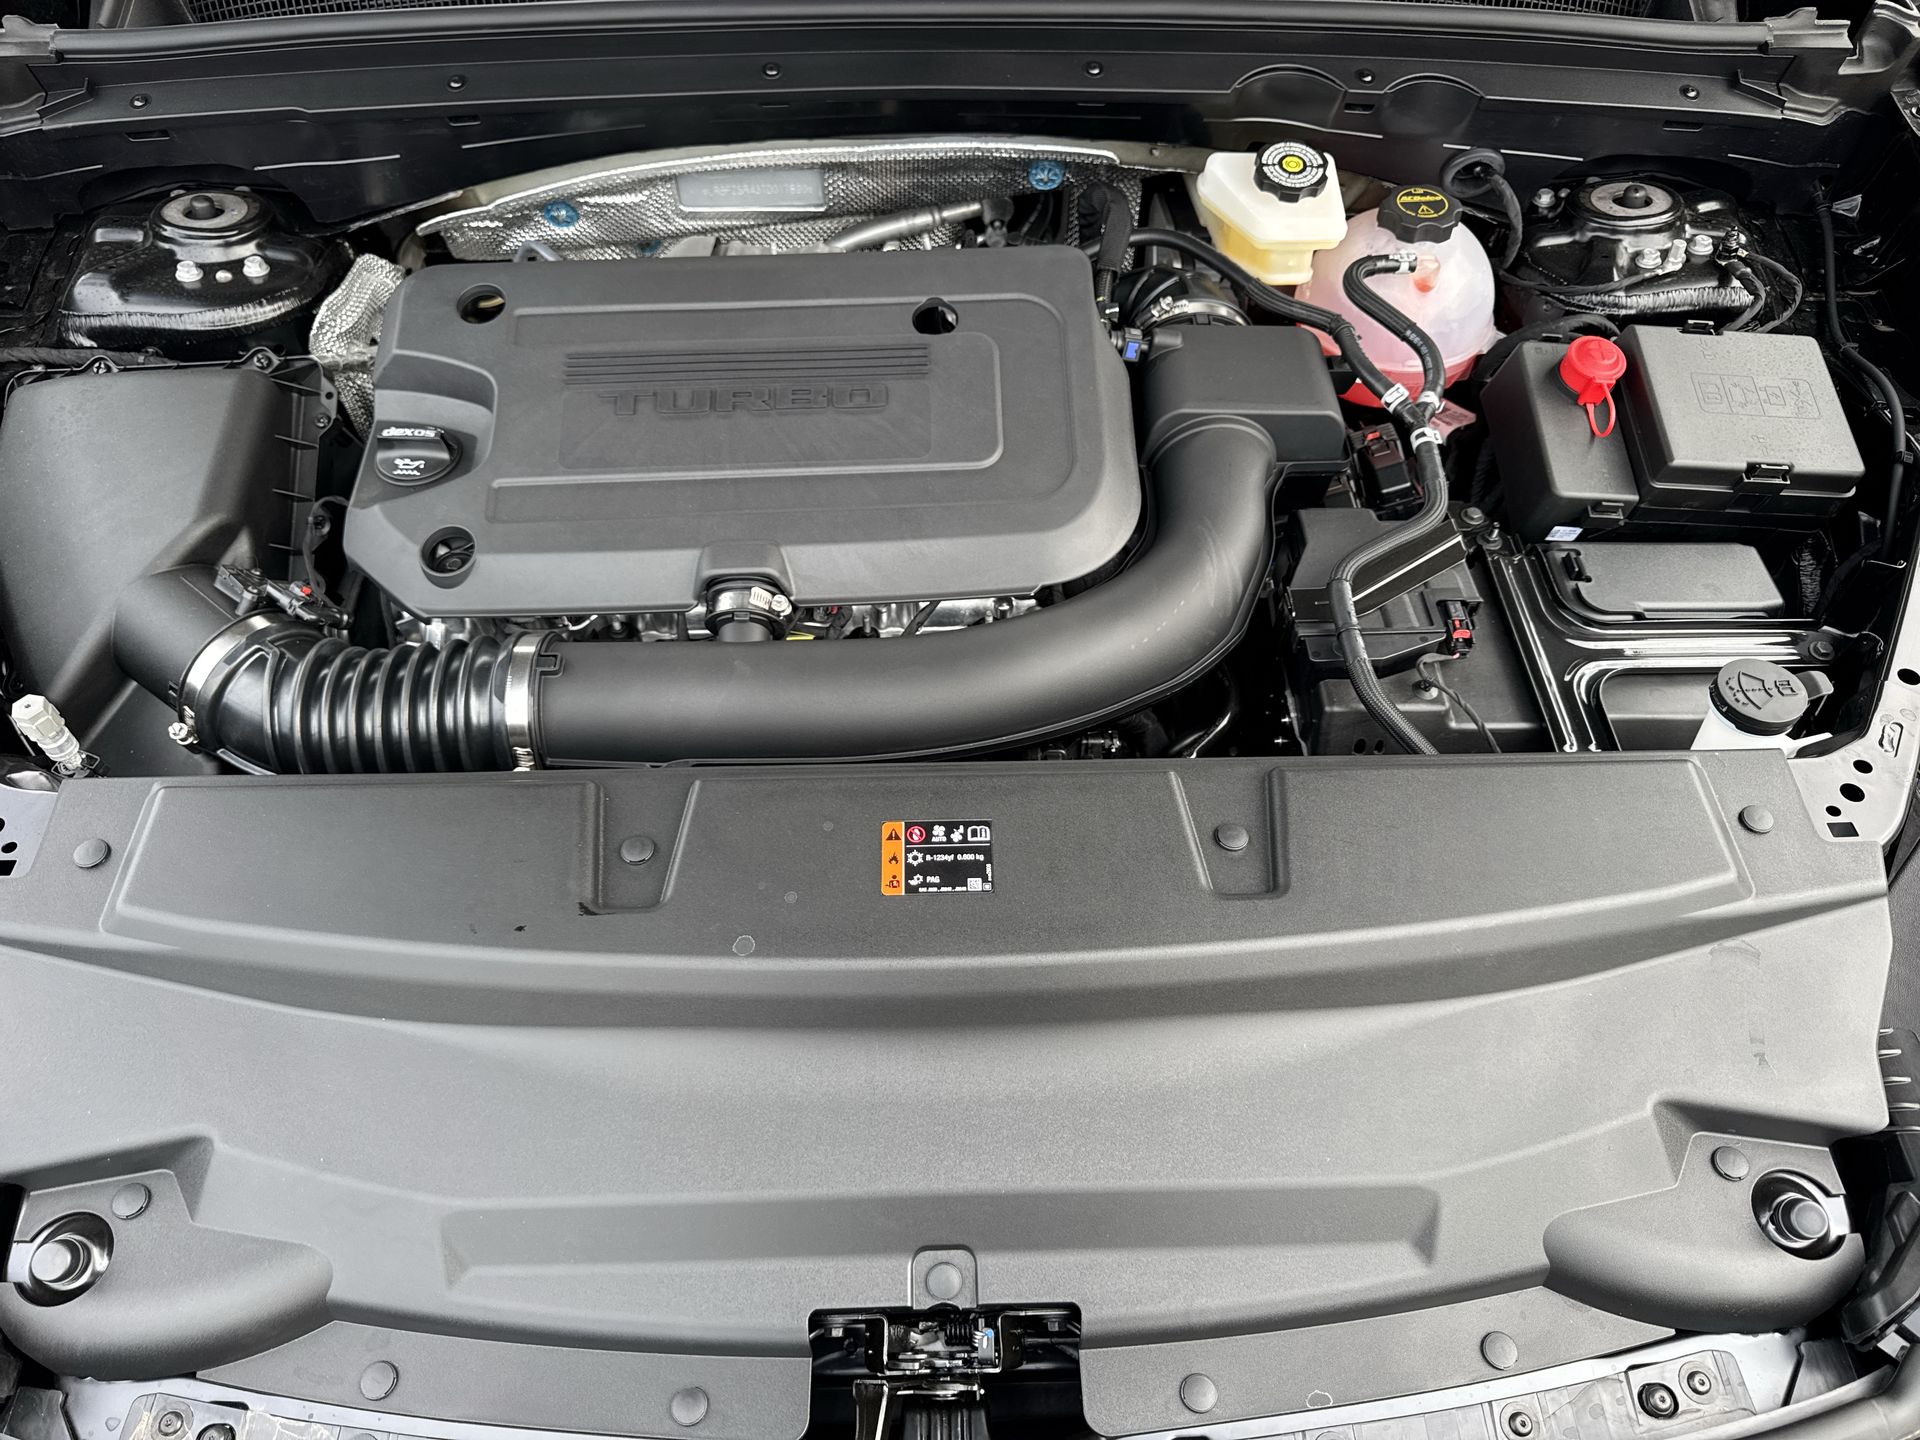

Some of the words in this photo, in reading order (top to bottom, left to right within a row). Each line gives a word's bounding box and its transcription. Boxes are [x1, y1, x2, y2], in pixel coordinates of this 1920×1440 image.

[599, 385, 888, 416] TURBO
[381, 427, 437, 438] dexos
[925, 853, 955, 862] R-1234yf
[975, 853, 985, 862] kg
[926, 875, 940, 883] PAG
